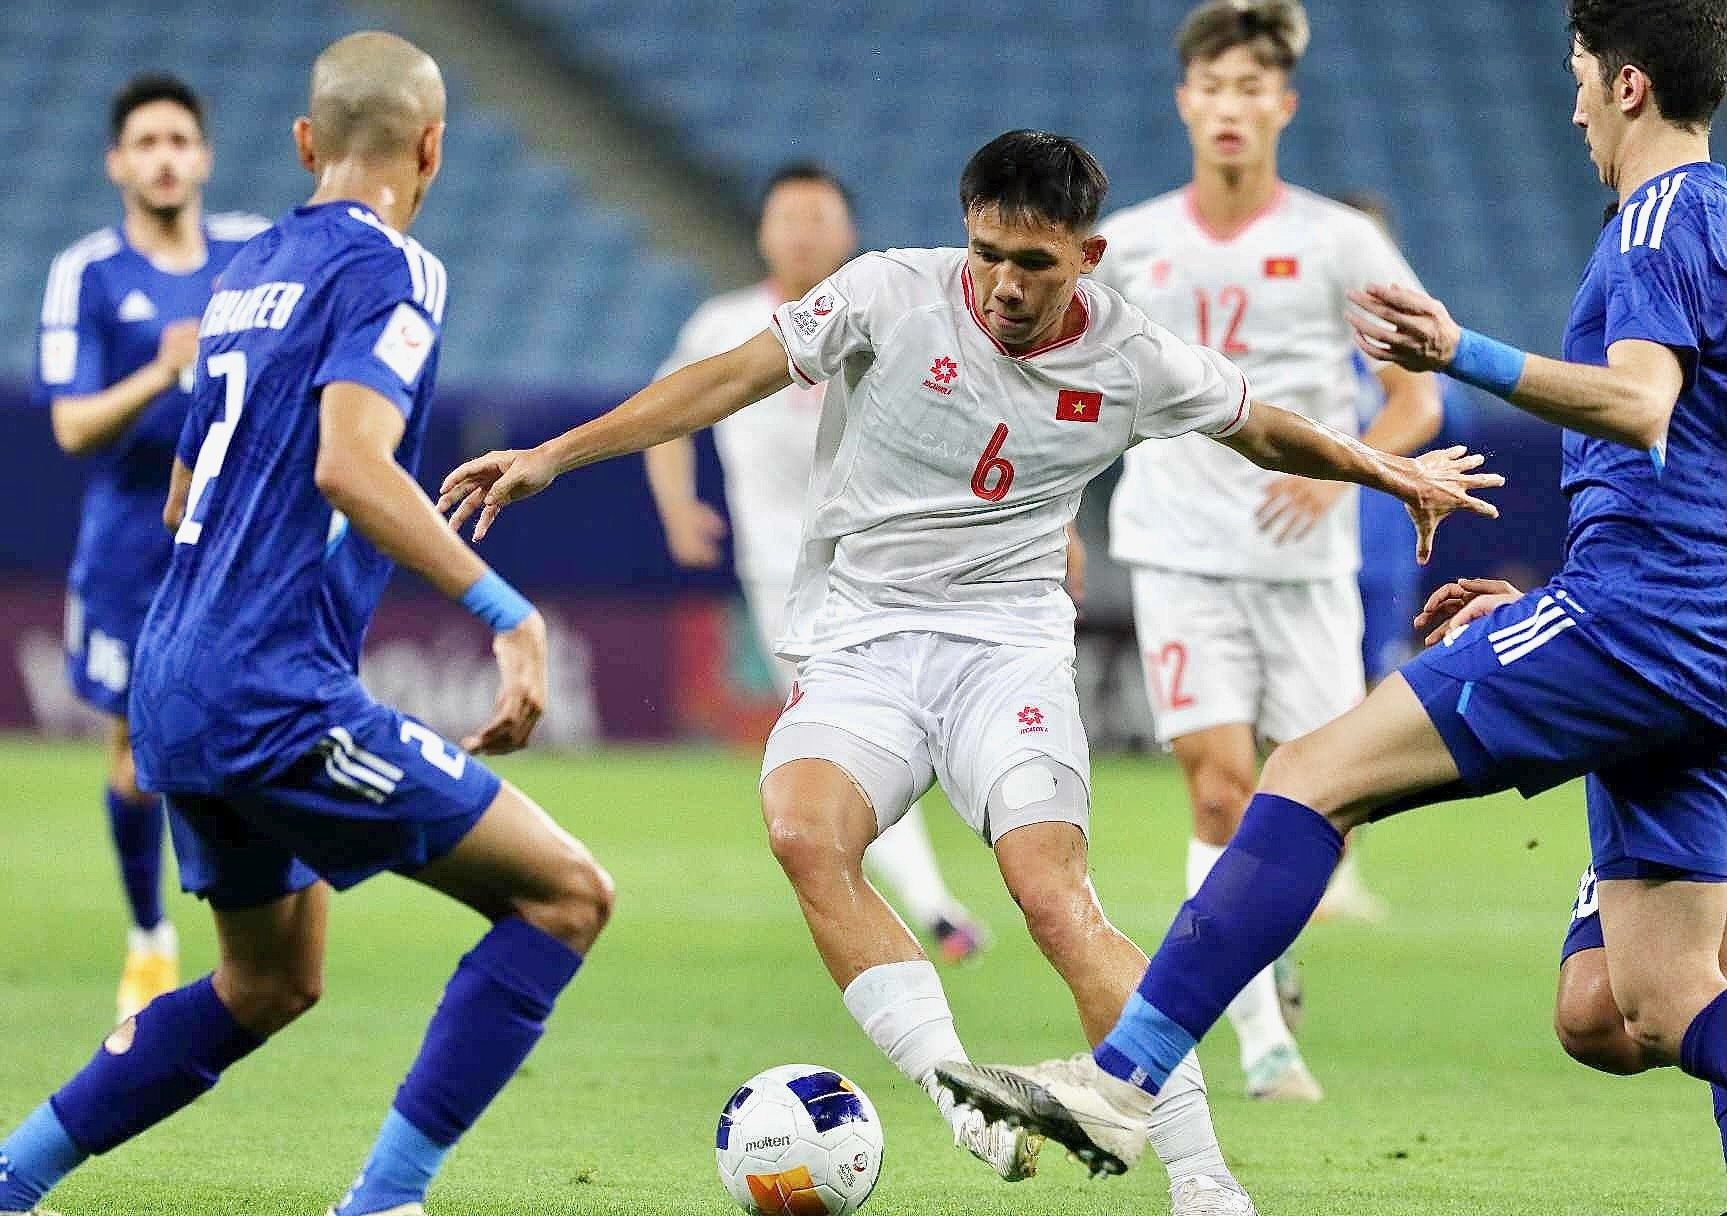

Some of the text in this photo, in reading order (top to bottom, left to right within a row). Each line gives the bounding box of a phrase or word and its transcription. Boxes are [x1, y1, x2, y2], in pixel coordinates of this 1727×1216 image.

[1193, 286, 1249, 354] 12
[971, 423, 1014, 502] 6
[400, 720, 465, 780] 2
[745, 1136, 790, 1152] molten
